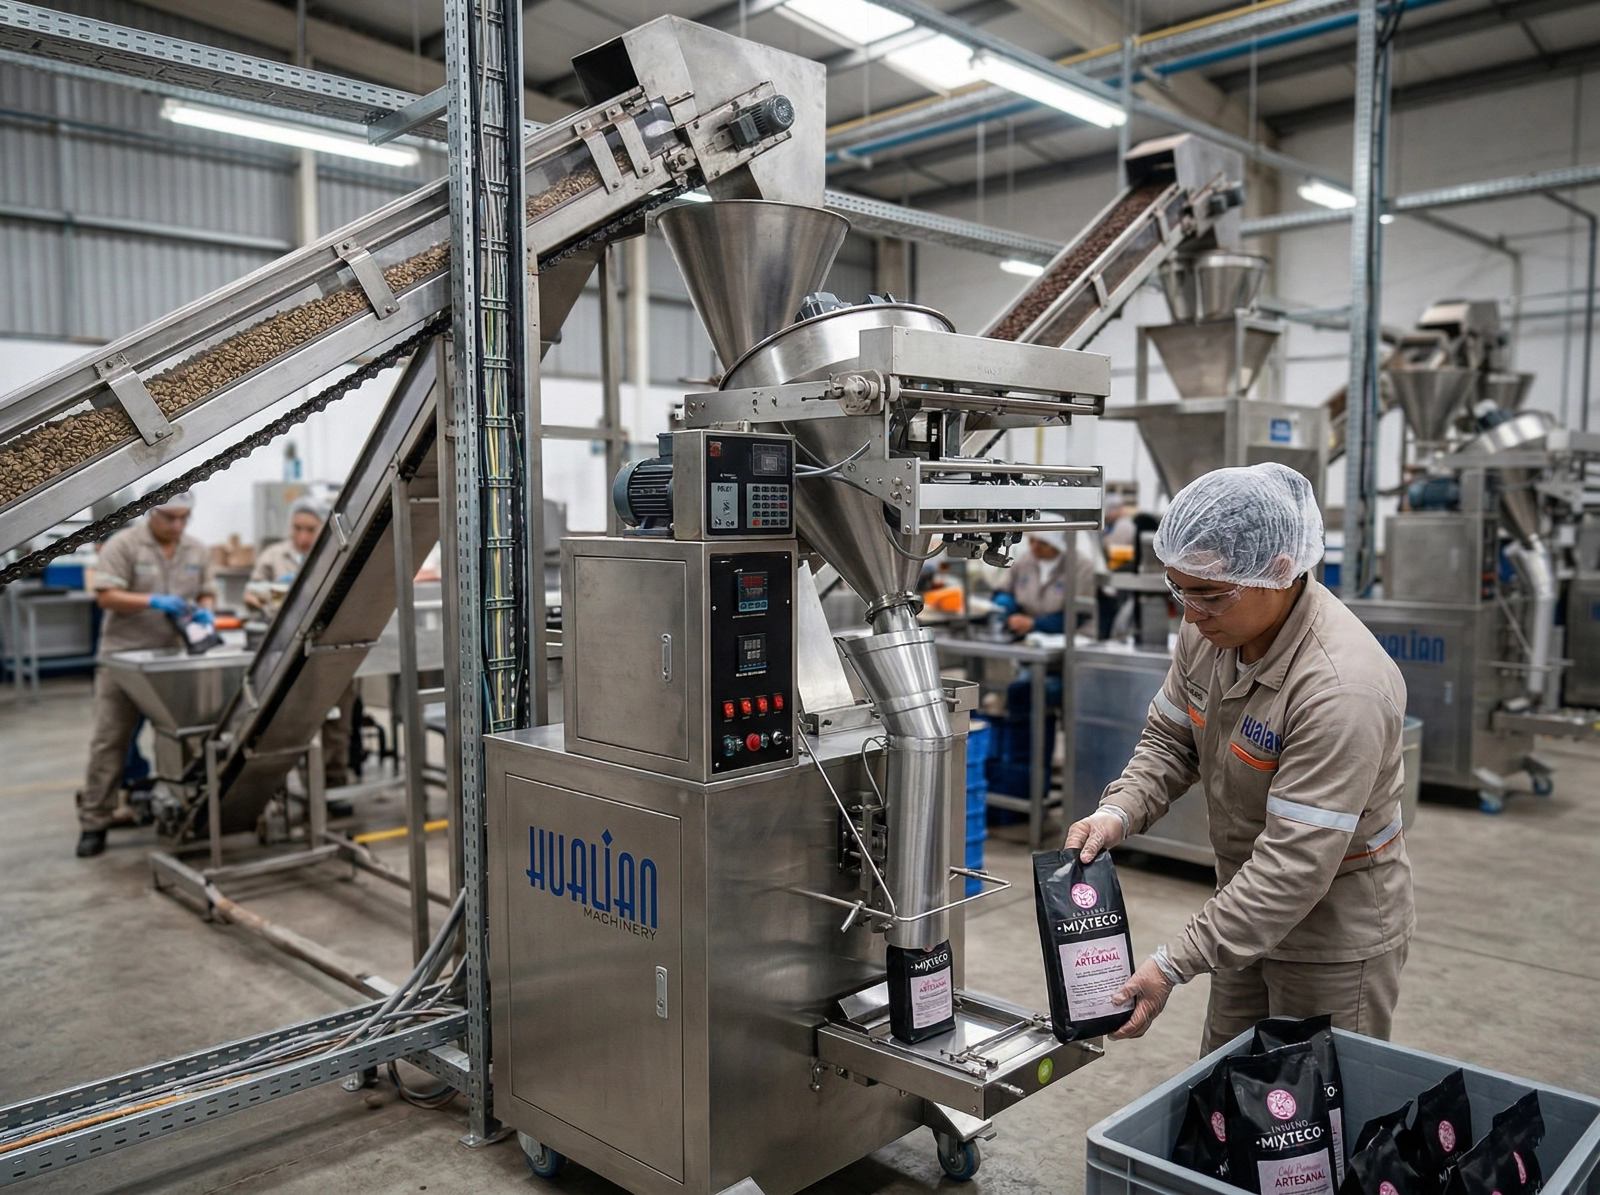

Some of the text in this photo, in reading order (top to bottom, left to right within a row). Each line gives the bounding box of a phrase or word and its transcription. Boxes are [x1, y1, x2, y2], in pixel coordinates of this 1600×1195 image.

[583, 907, 657, 941] MACHINERY
[1063, 914, 1118, 935] MIXTECO
[914, 953, 948, 971] MIXTECO
[1075, 951, 1121, 968] ARTESANAL
[1260, 1126, 1322, 1151] MIXTECO
[1275, 1169, 1326, 1188] ARTESANAL
